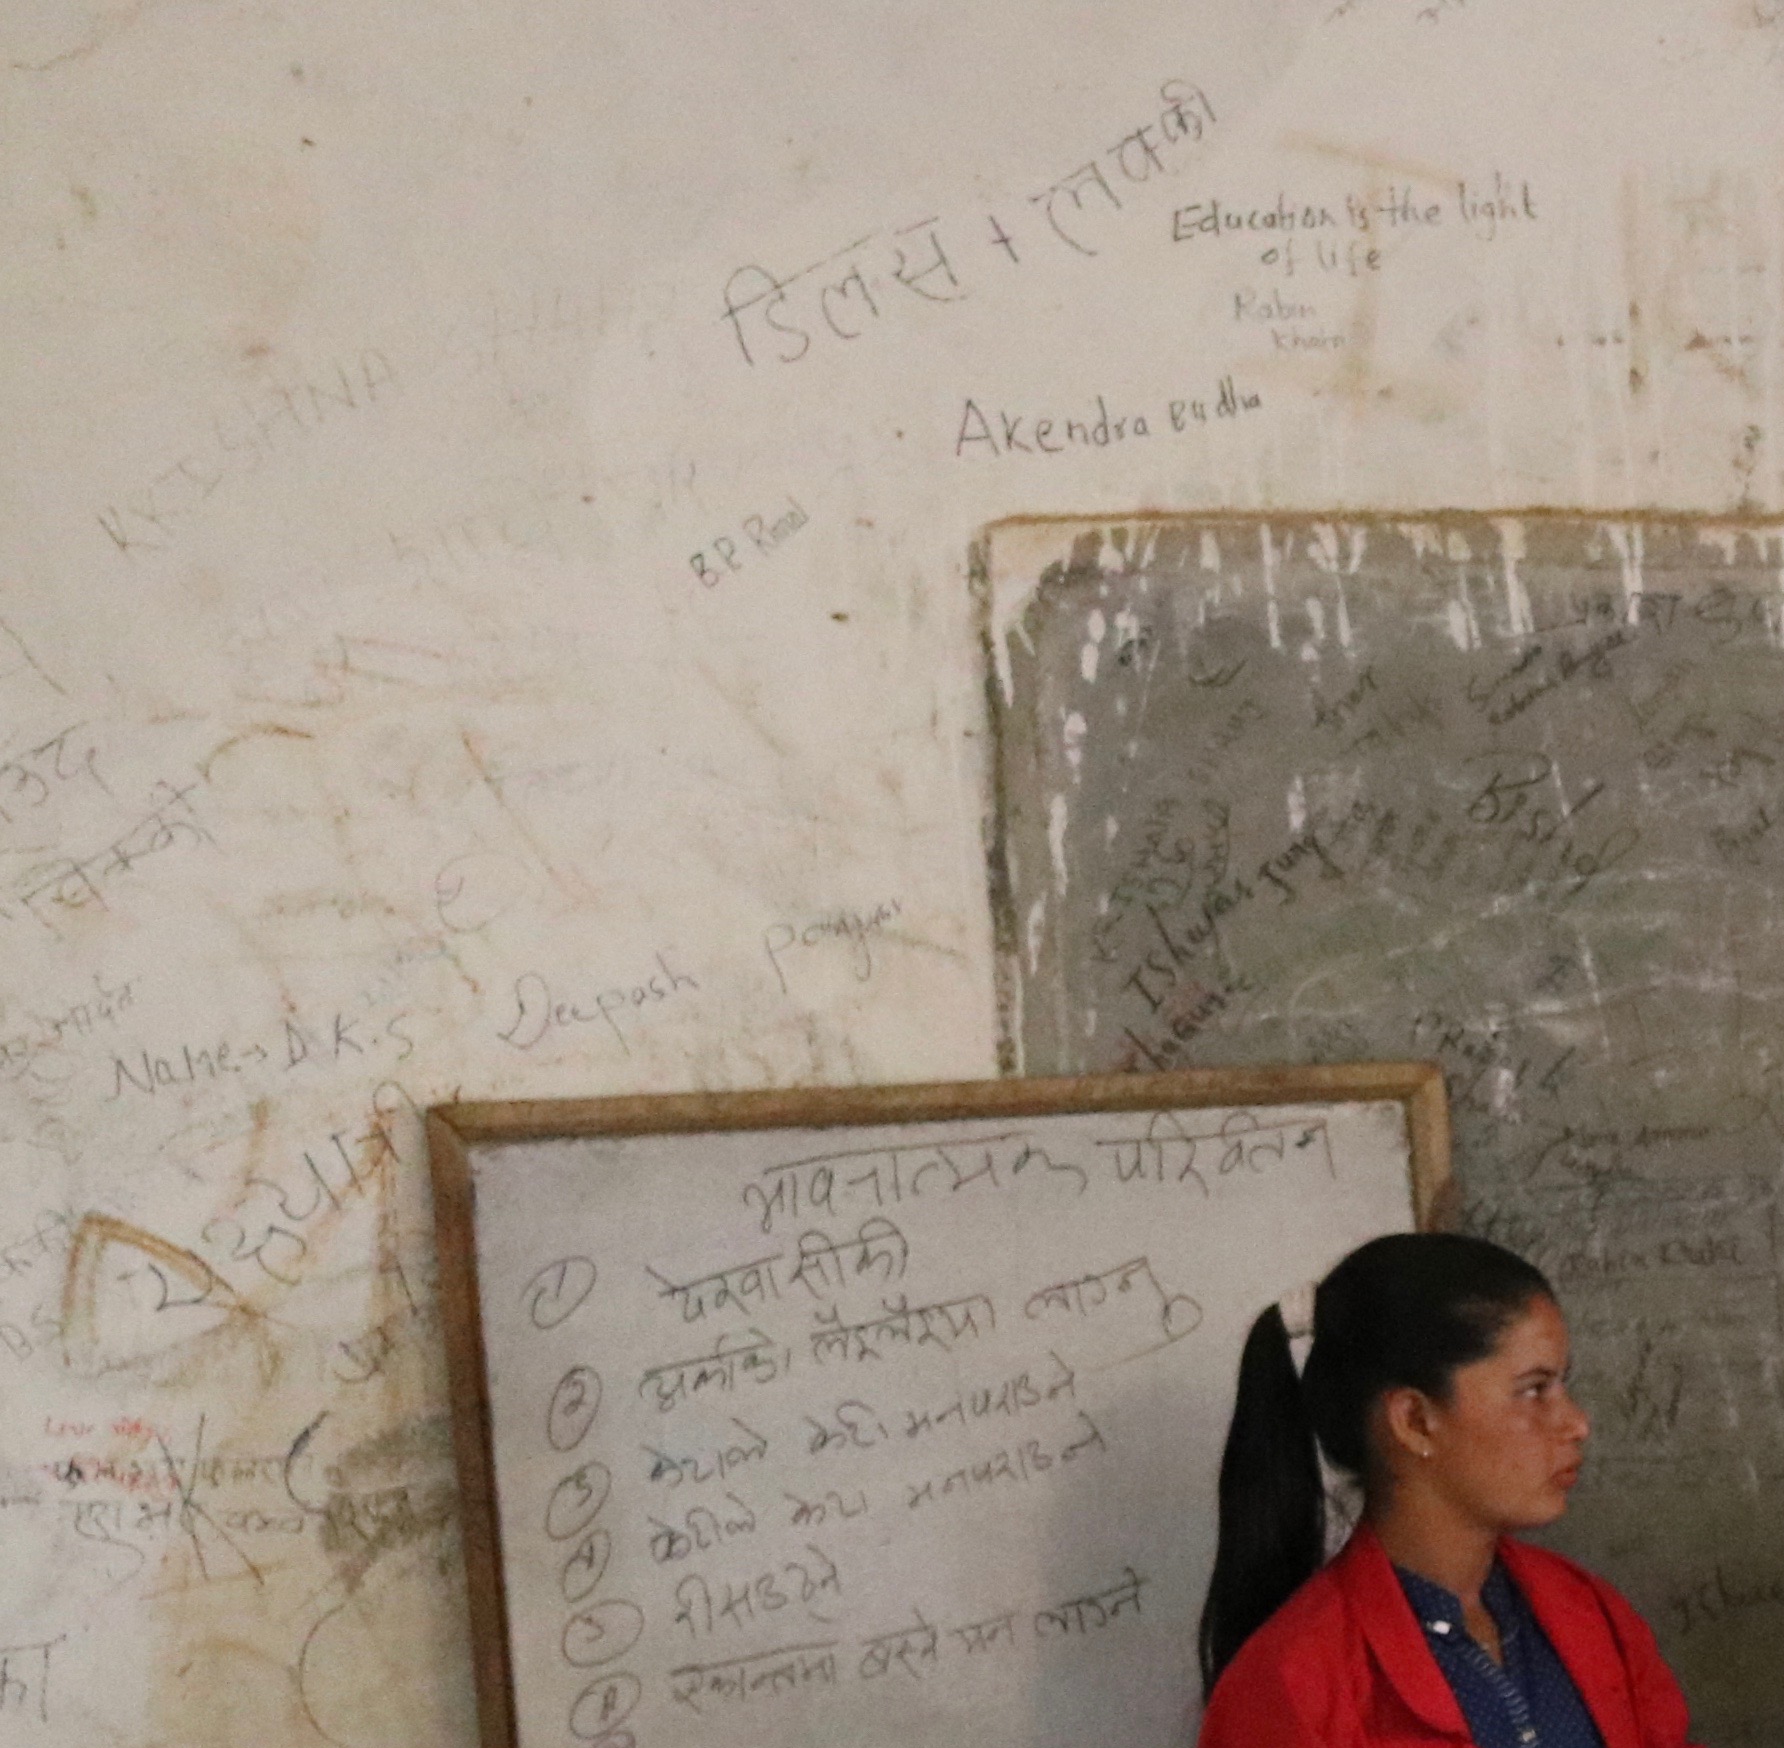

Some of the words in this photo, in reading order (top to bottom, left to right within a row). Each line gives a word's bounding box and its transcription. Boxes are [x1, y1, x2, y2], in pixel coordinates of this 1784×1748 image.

[1173, 192, 1335, 241] Education
[1378, 185, 1440, 228] the
[1458, 171, 1537, 241] light
[1260, 238, 1298, 276] of
